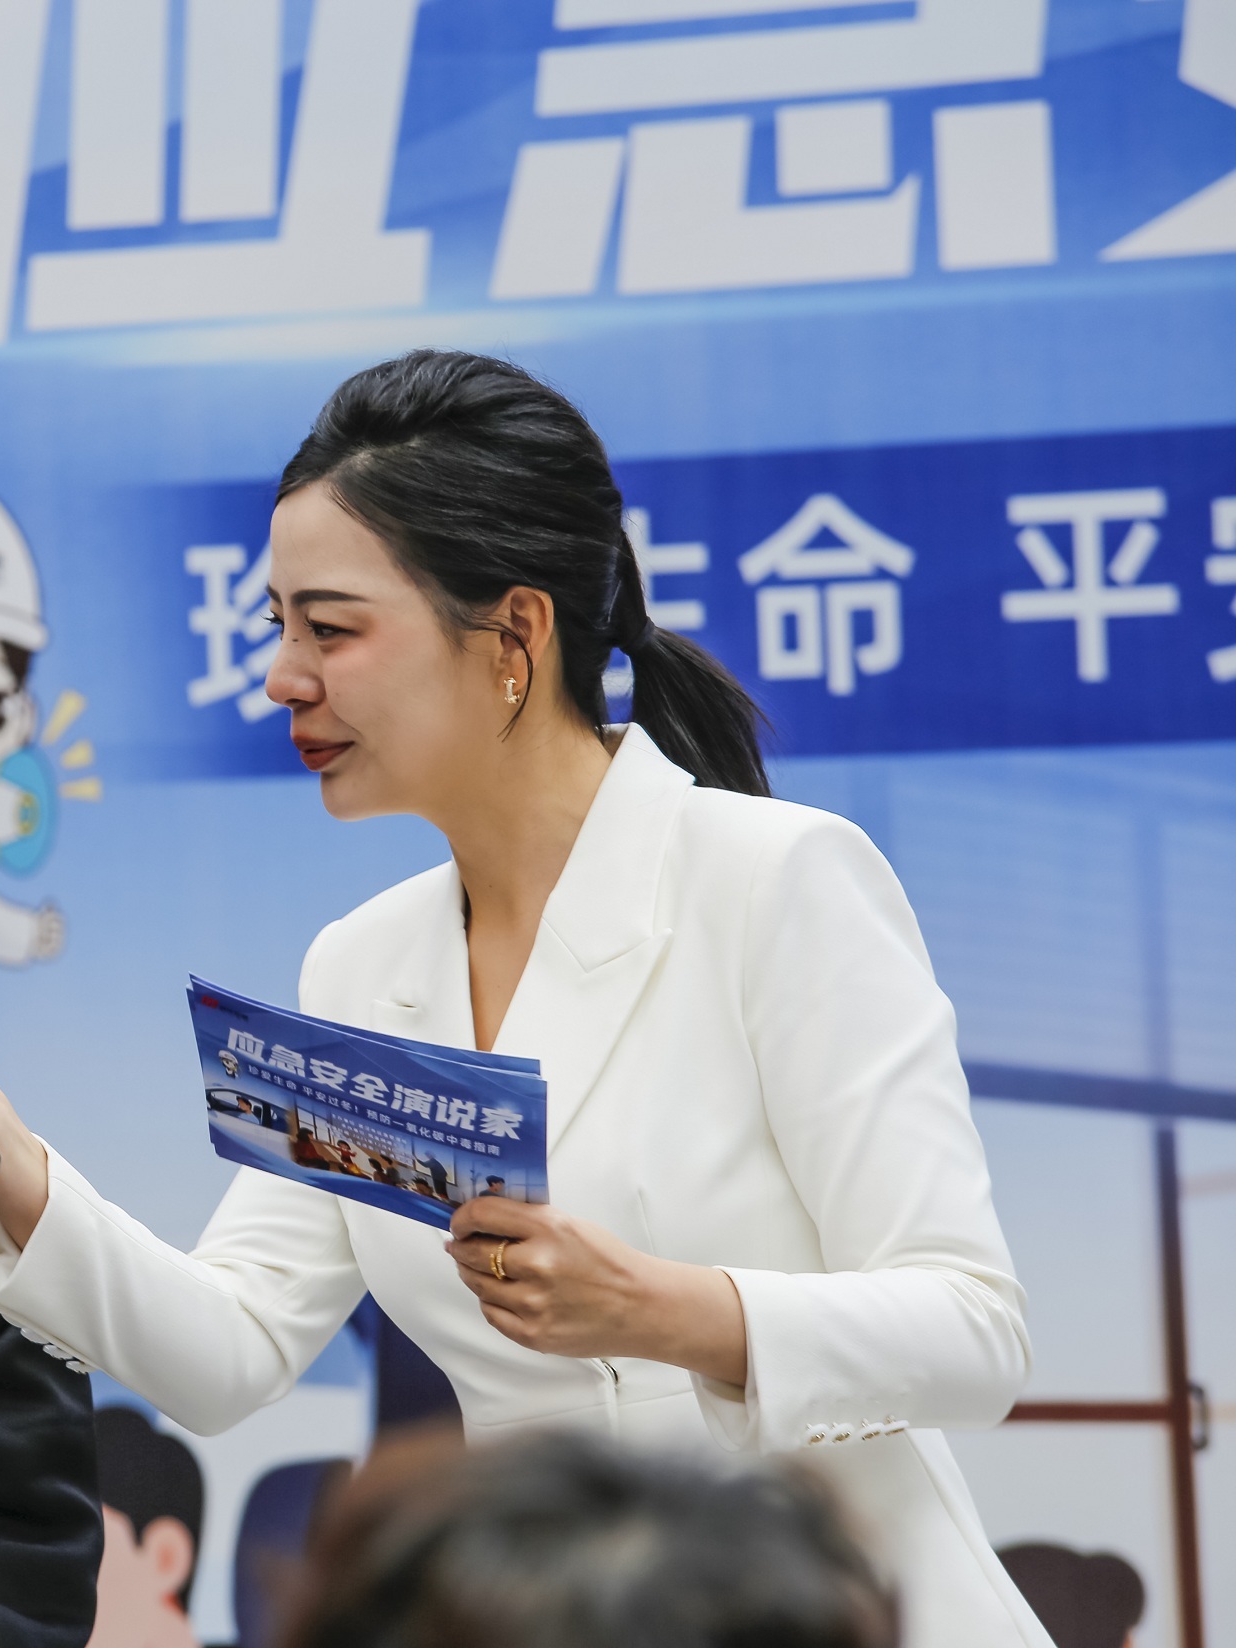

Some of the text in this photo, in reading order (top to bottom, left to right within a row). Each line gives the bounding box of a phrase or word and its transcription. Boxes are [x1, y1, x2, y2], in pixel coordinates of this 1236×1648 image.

[1001, 486, 1236, 684] 平
[227, 1027, 524, 1141] 应急安全演说家
[248, 1064, 297, 1091] 珍爱生命
